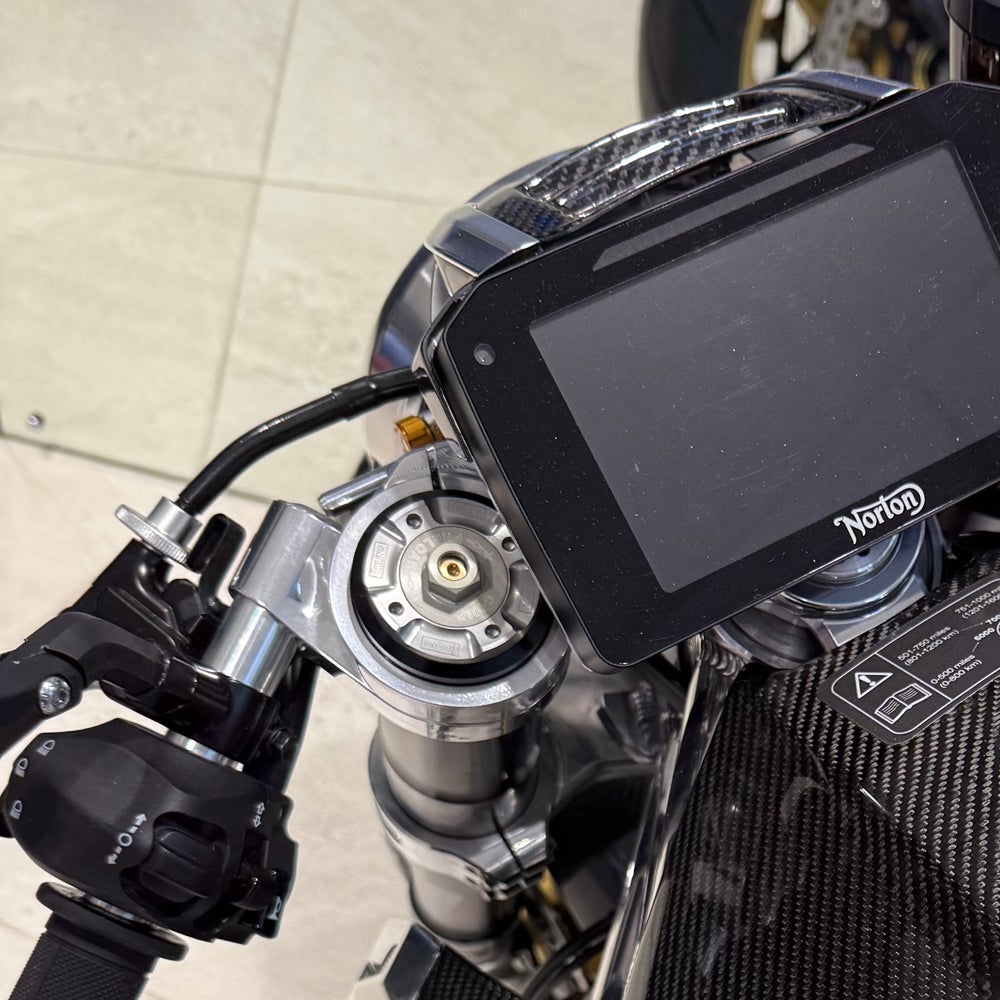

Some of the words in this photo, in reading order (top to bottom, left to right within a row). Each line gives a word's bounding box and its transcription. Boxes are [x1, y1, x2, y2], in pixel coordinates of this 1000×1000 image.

[833, 482, 925, 545] Norton
[954, 592, 991, 614] 751-1000
[898, 639, 929, 661] 501-750
[930, 627, 951, 640] miles
[904, 639, 943, 666] (801-1200
[942, 629, 959, 641] km)
[974, 627, 995, 641] 6000
[930, 667, 954, 684] 0-500
[954, 654, 975, 669] miles
[940, 669, 965, 688] (0-800
[964, 659, 982, 671] km)
